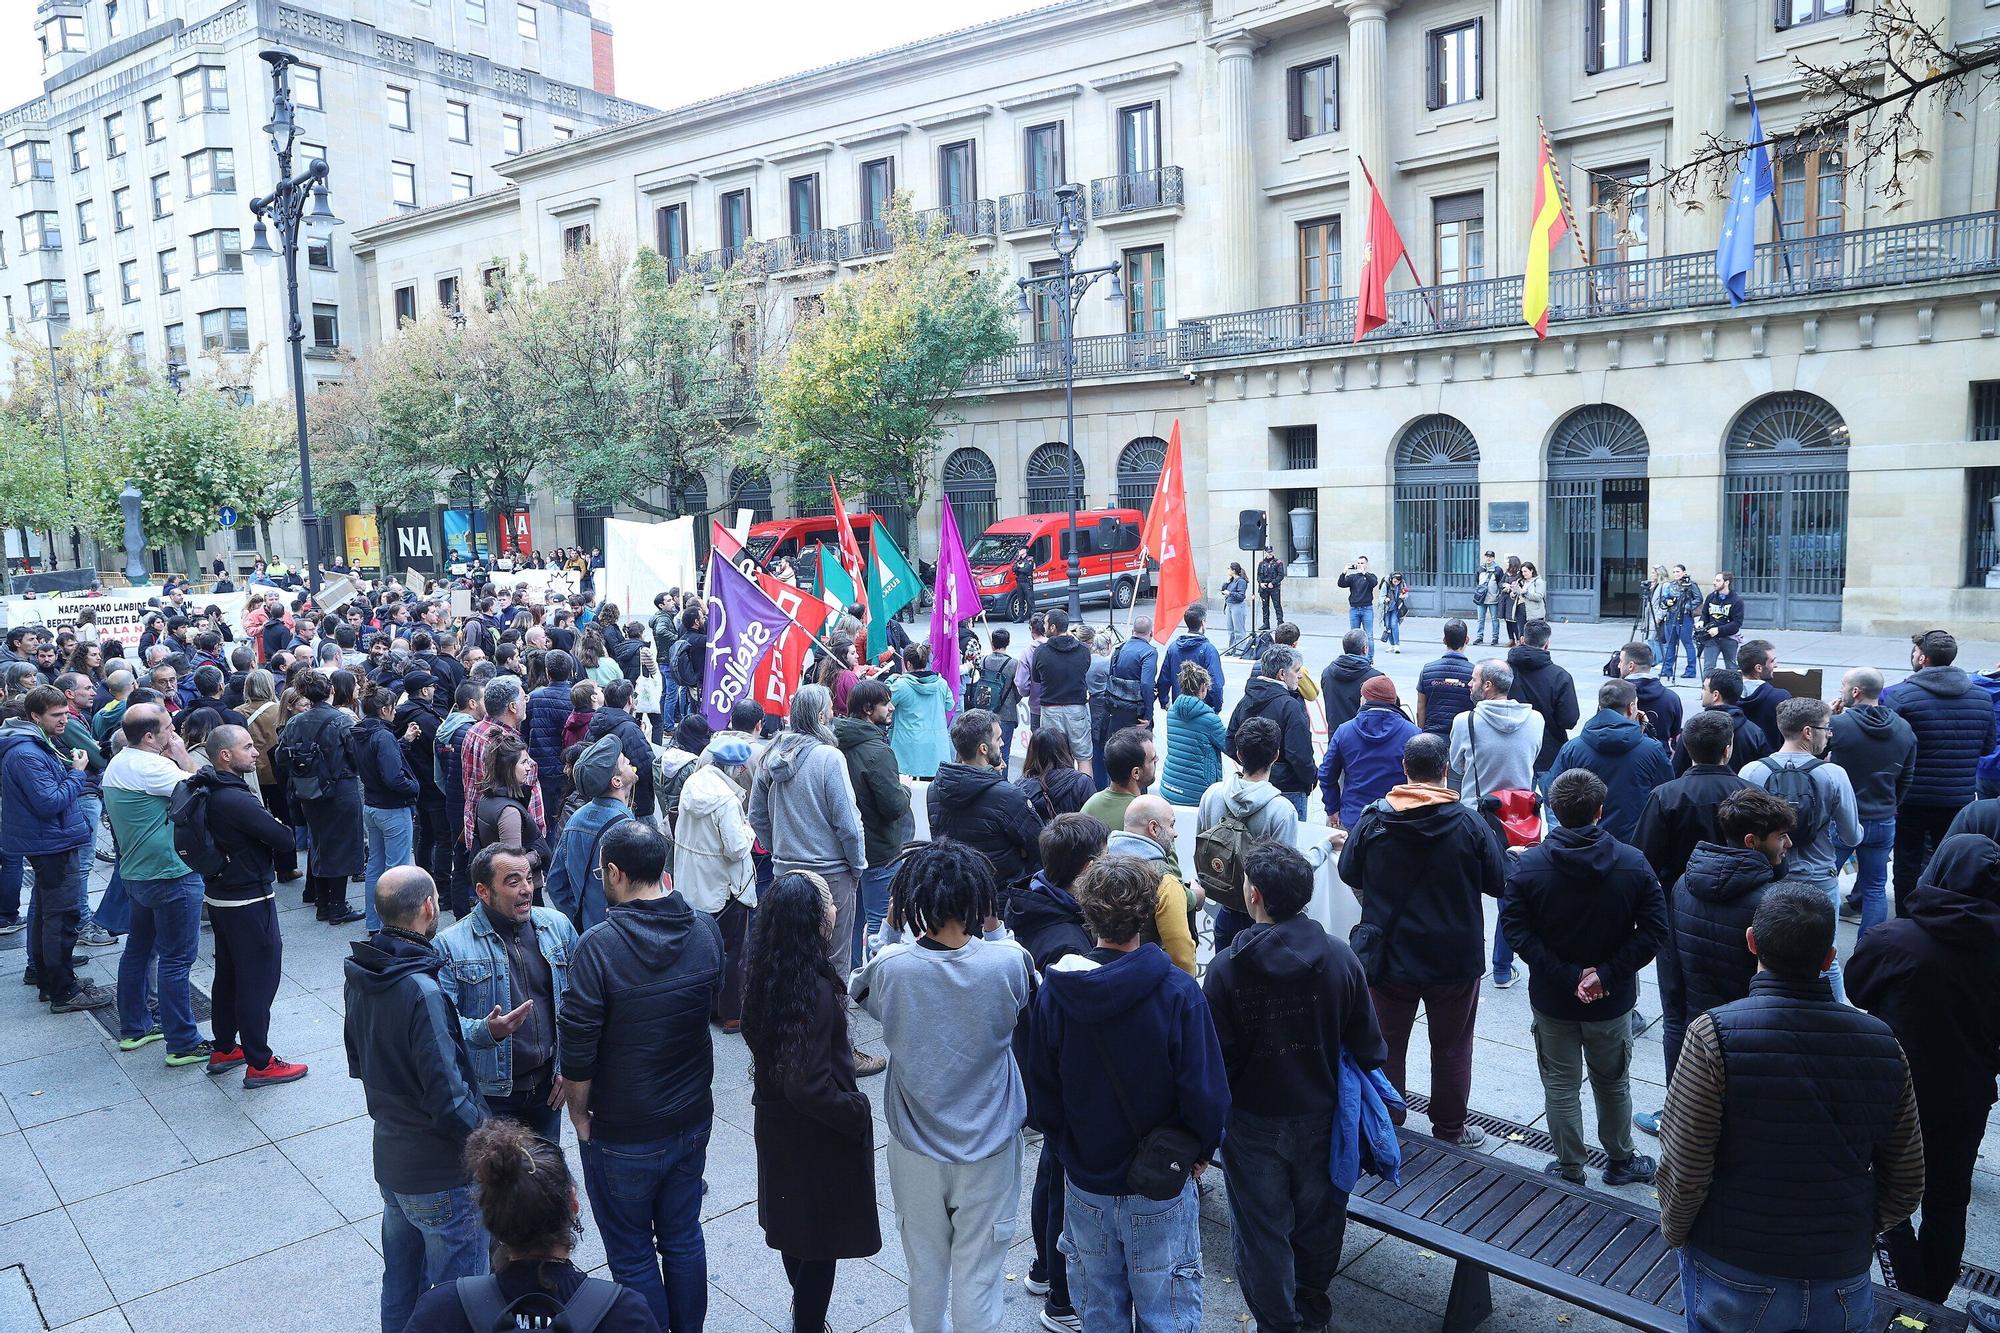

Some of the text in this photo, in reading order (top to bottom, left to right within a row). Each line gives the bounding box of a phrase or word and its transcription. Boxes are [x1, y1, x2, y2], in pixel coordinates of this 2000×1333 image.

[397, 527, 433, 557] NA
[58, 603, 112, 614] NAFAROAKO
[96, 615, 129, 625] RIZKETA
